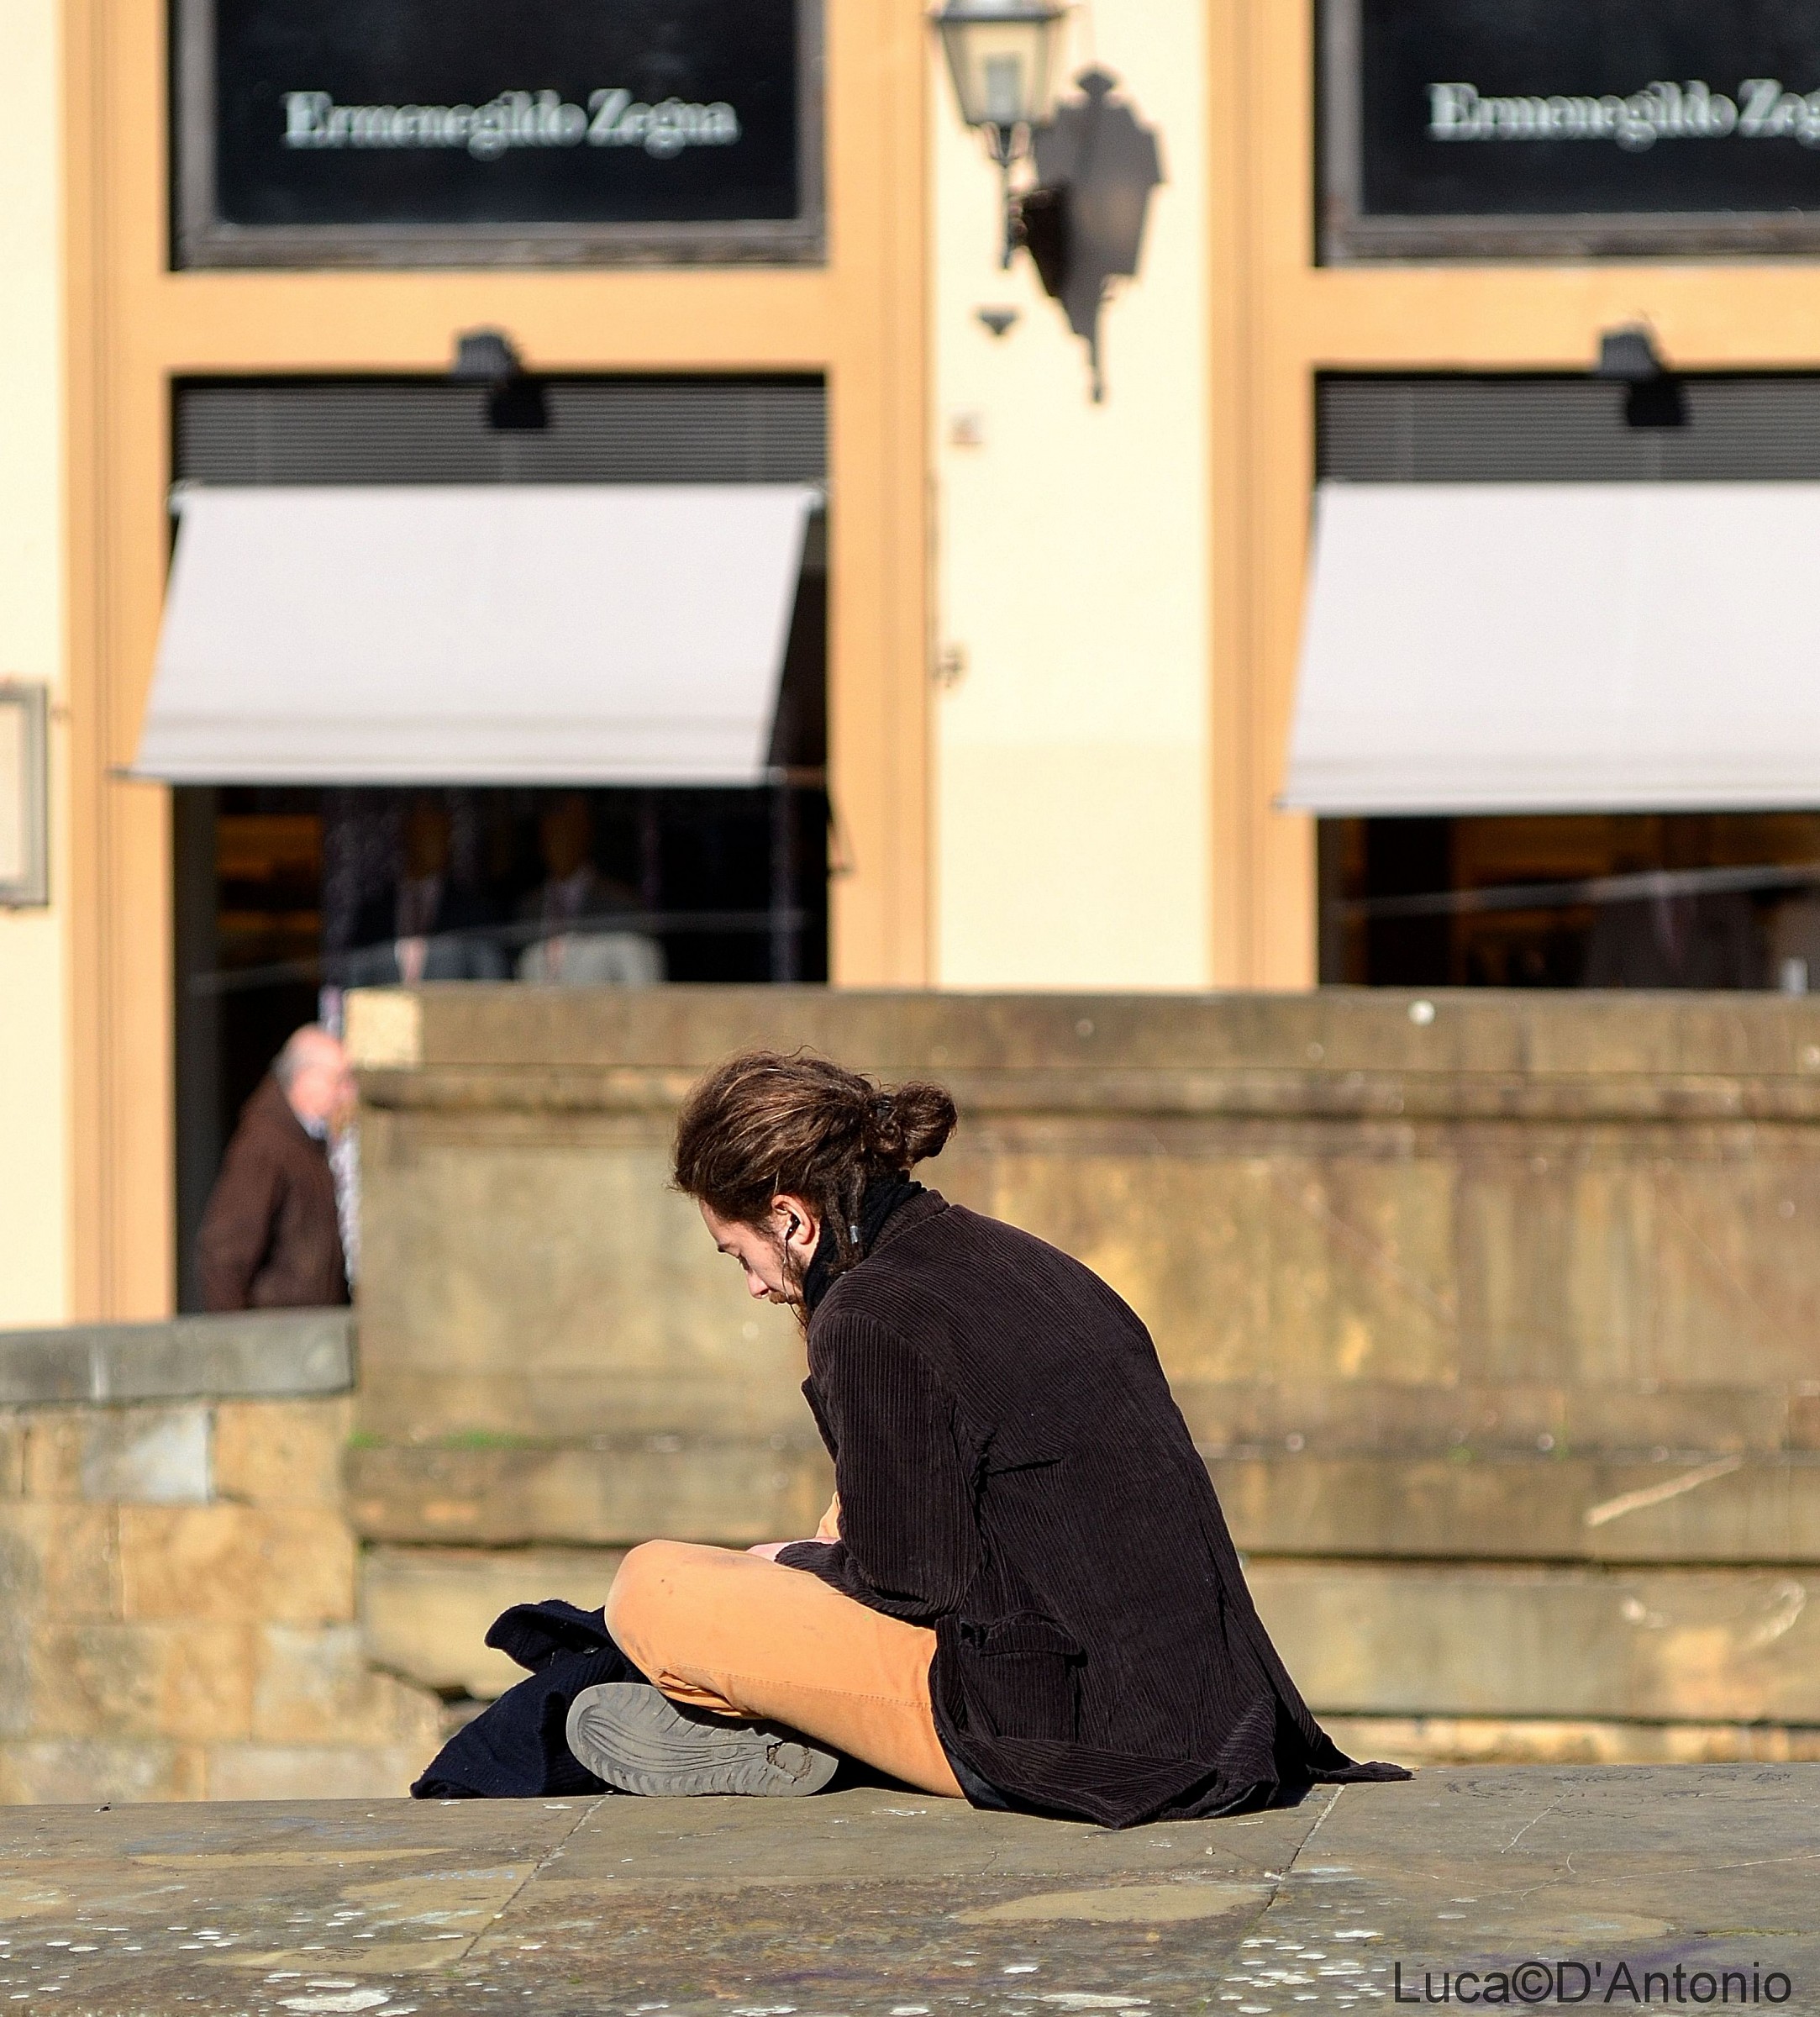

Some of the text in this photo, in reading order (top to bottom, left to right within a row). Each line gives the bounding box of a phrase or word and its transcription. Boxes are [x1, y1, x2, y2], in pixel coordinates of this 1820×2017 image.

[282, 87, 739, 160] Ermenegildo Zegna
[1428, 81, 1738, 153] Ermenegildo
